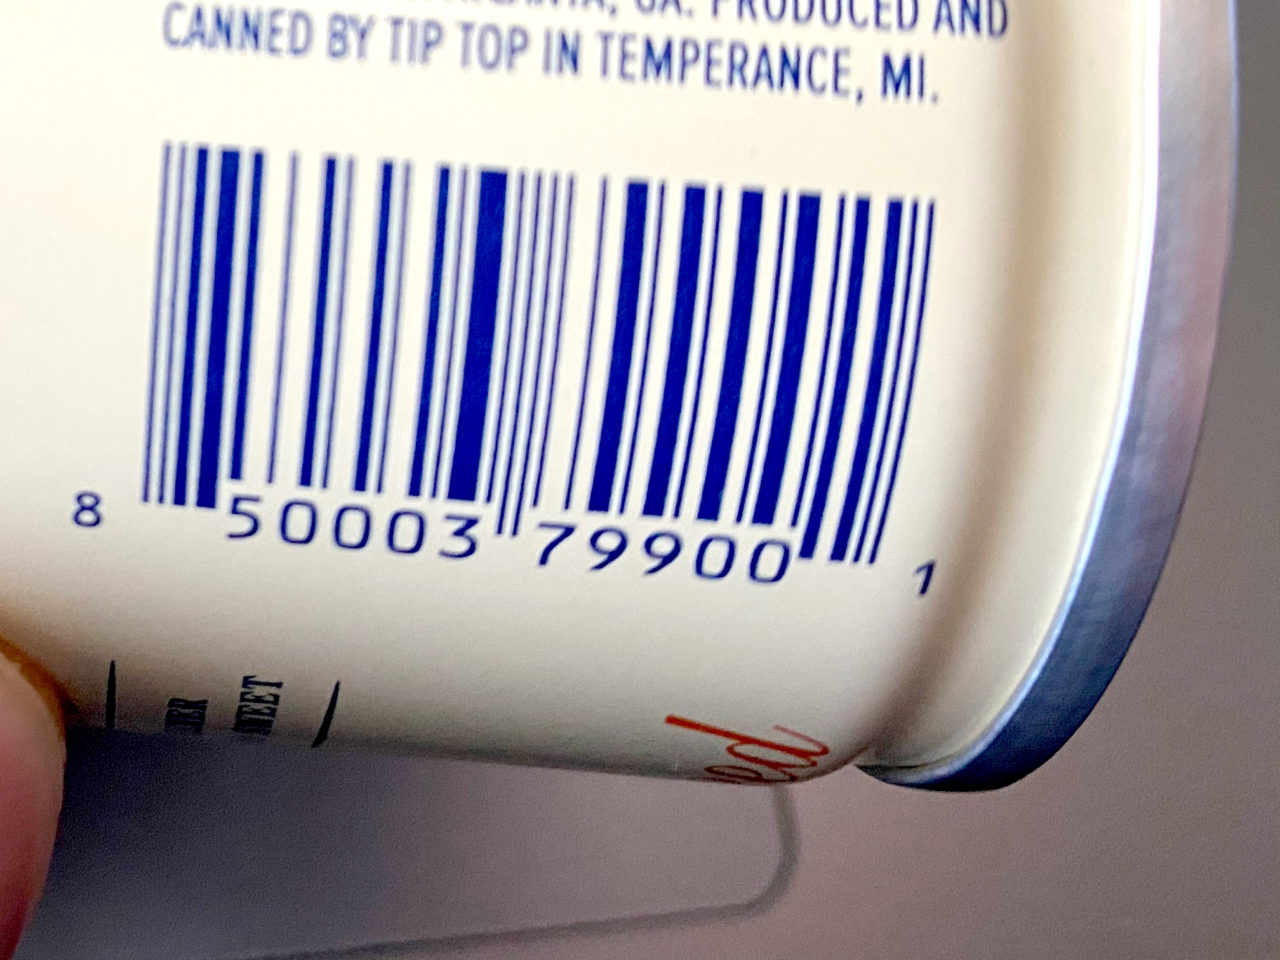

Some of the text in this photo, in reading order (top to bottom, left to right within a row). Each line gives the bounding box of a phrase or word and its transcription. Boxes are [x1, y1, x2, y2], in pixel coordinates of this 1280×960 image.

[162, 0, 939, 106] CANNED BY TIP TOP IN TEMPERANCE, MI.
[73, 491, 937, 597] 8 50003 79900 1
